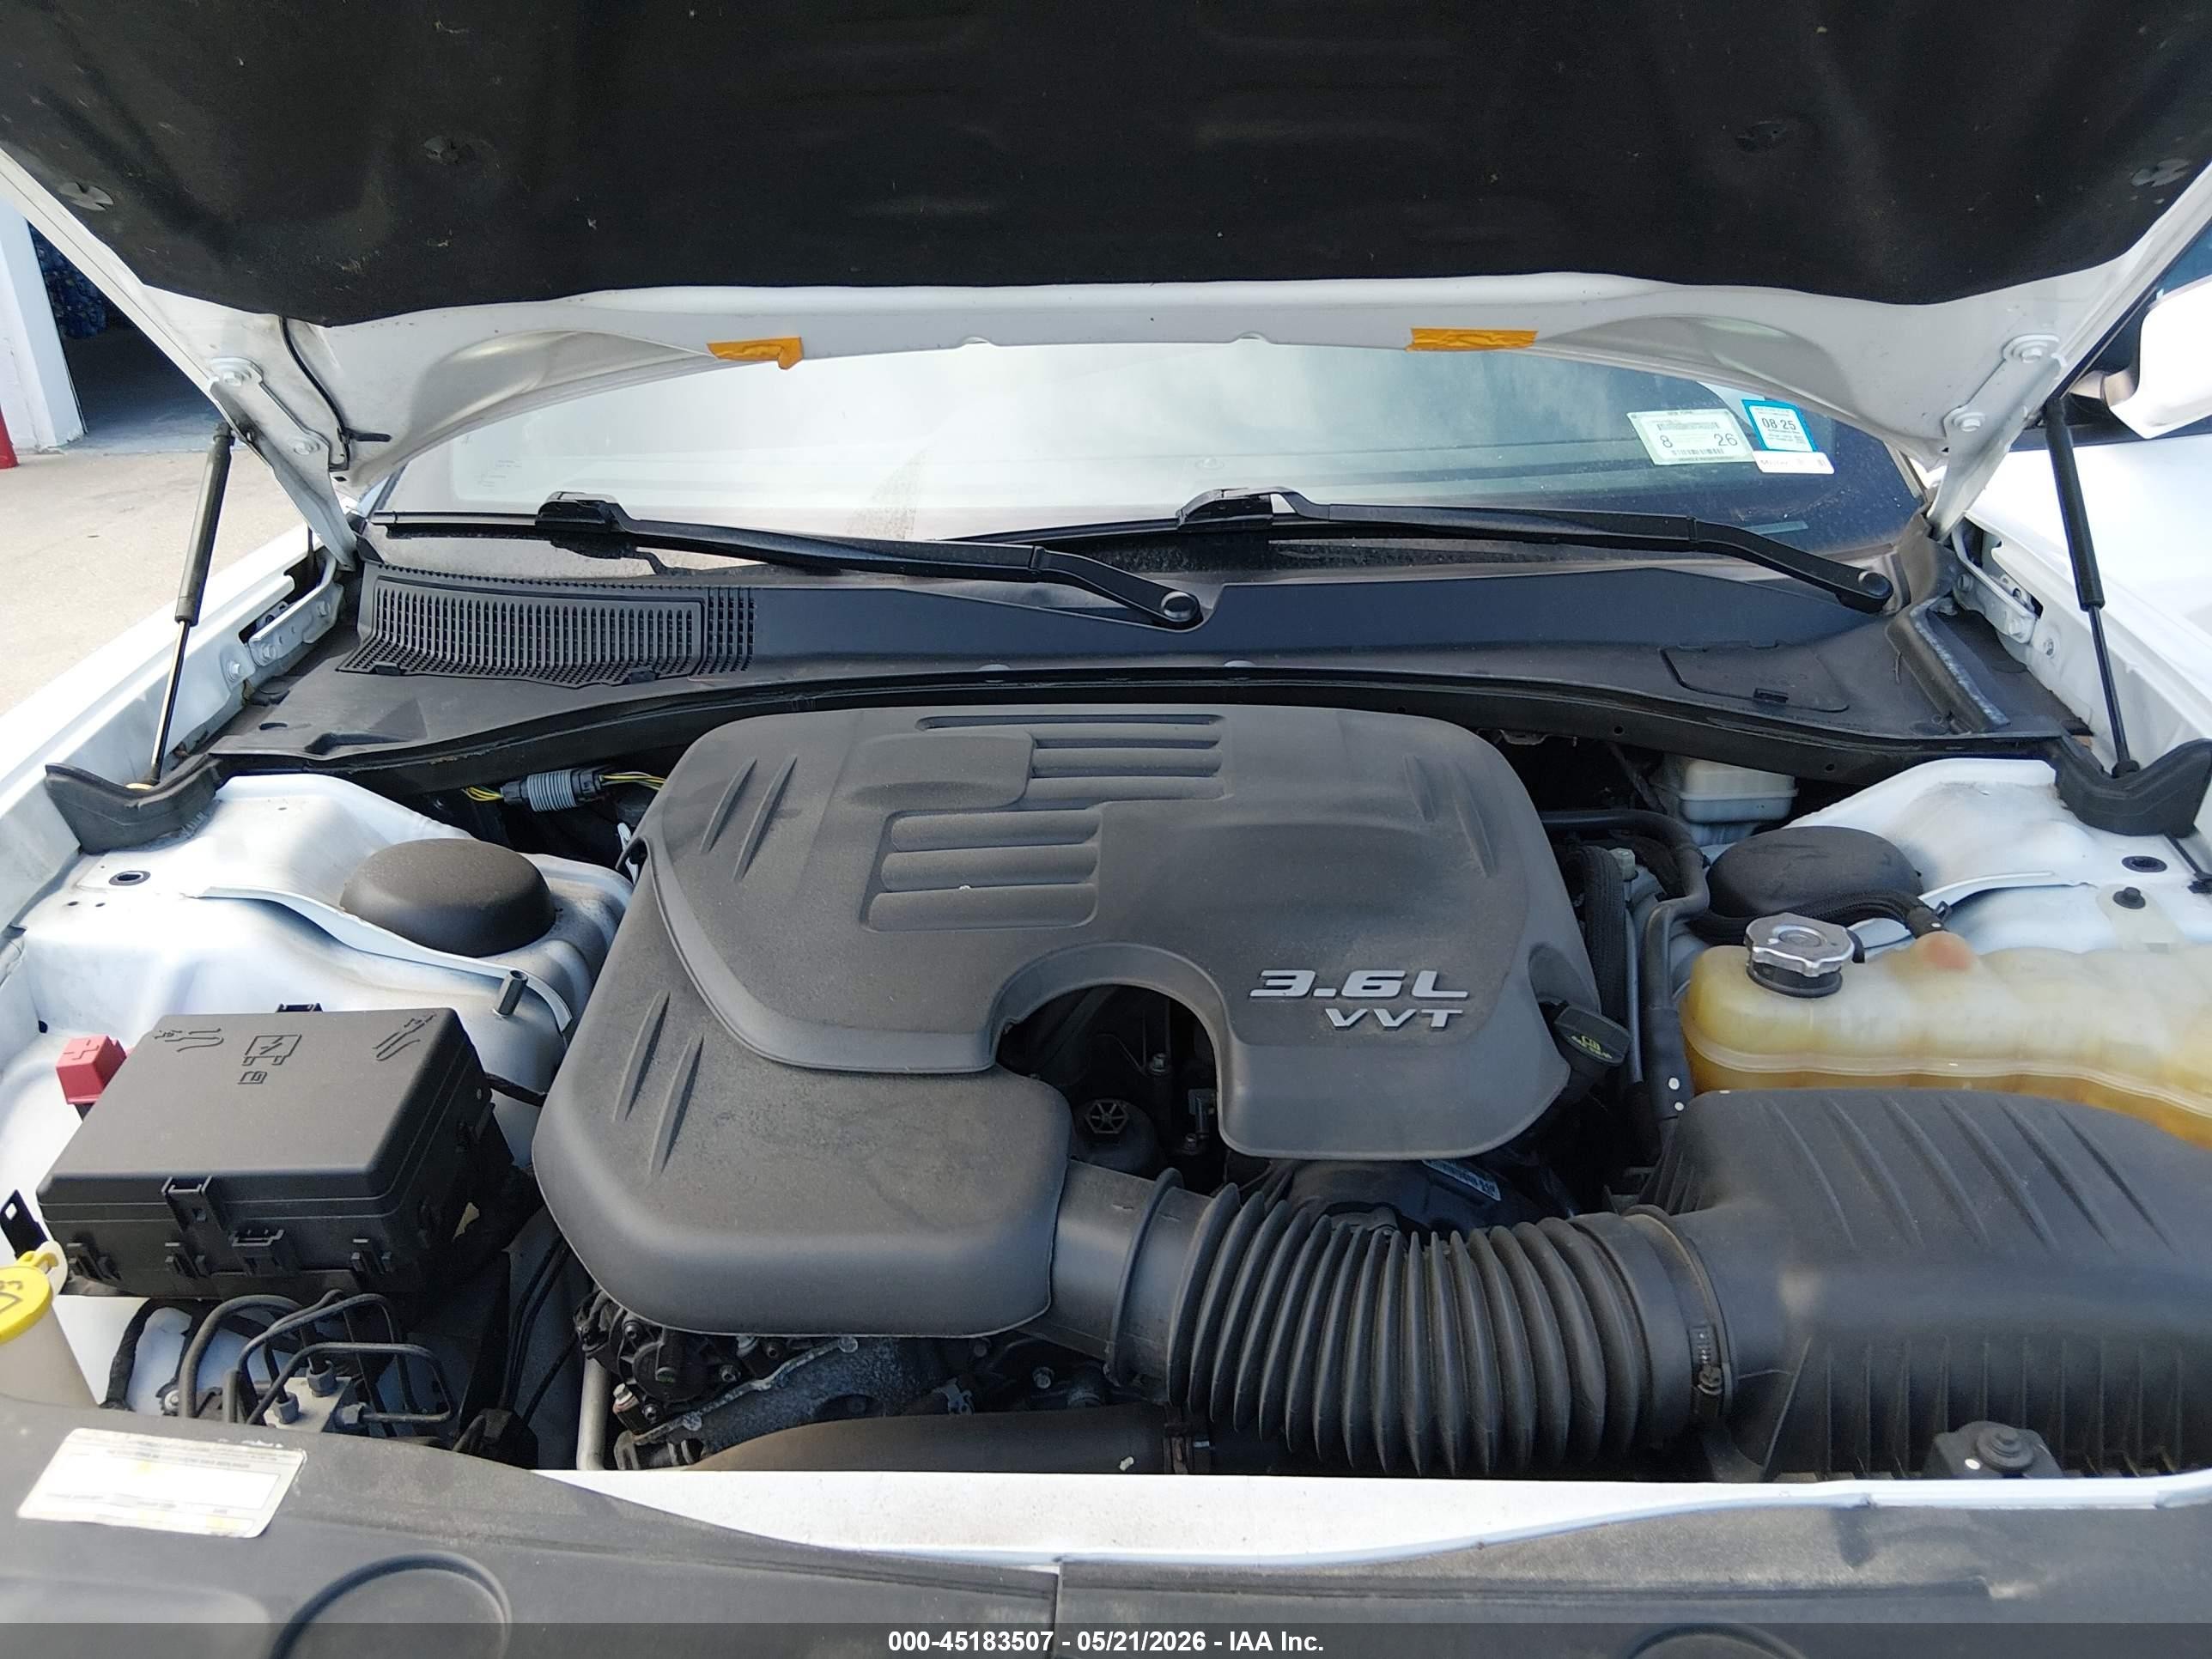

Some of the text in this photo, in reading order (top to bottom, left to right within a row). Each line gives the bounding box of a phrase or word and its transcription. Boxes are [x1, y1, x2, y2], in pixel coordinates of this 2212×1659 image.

[1659, 434, 1673, 448] 8
[1714, 433, 1738, 447] 26
[1249, 969, 1469, 999] 3.6L
[1324, 1008, 1463, 1029] VVT
